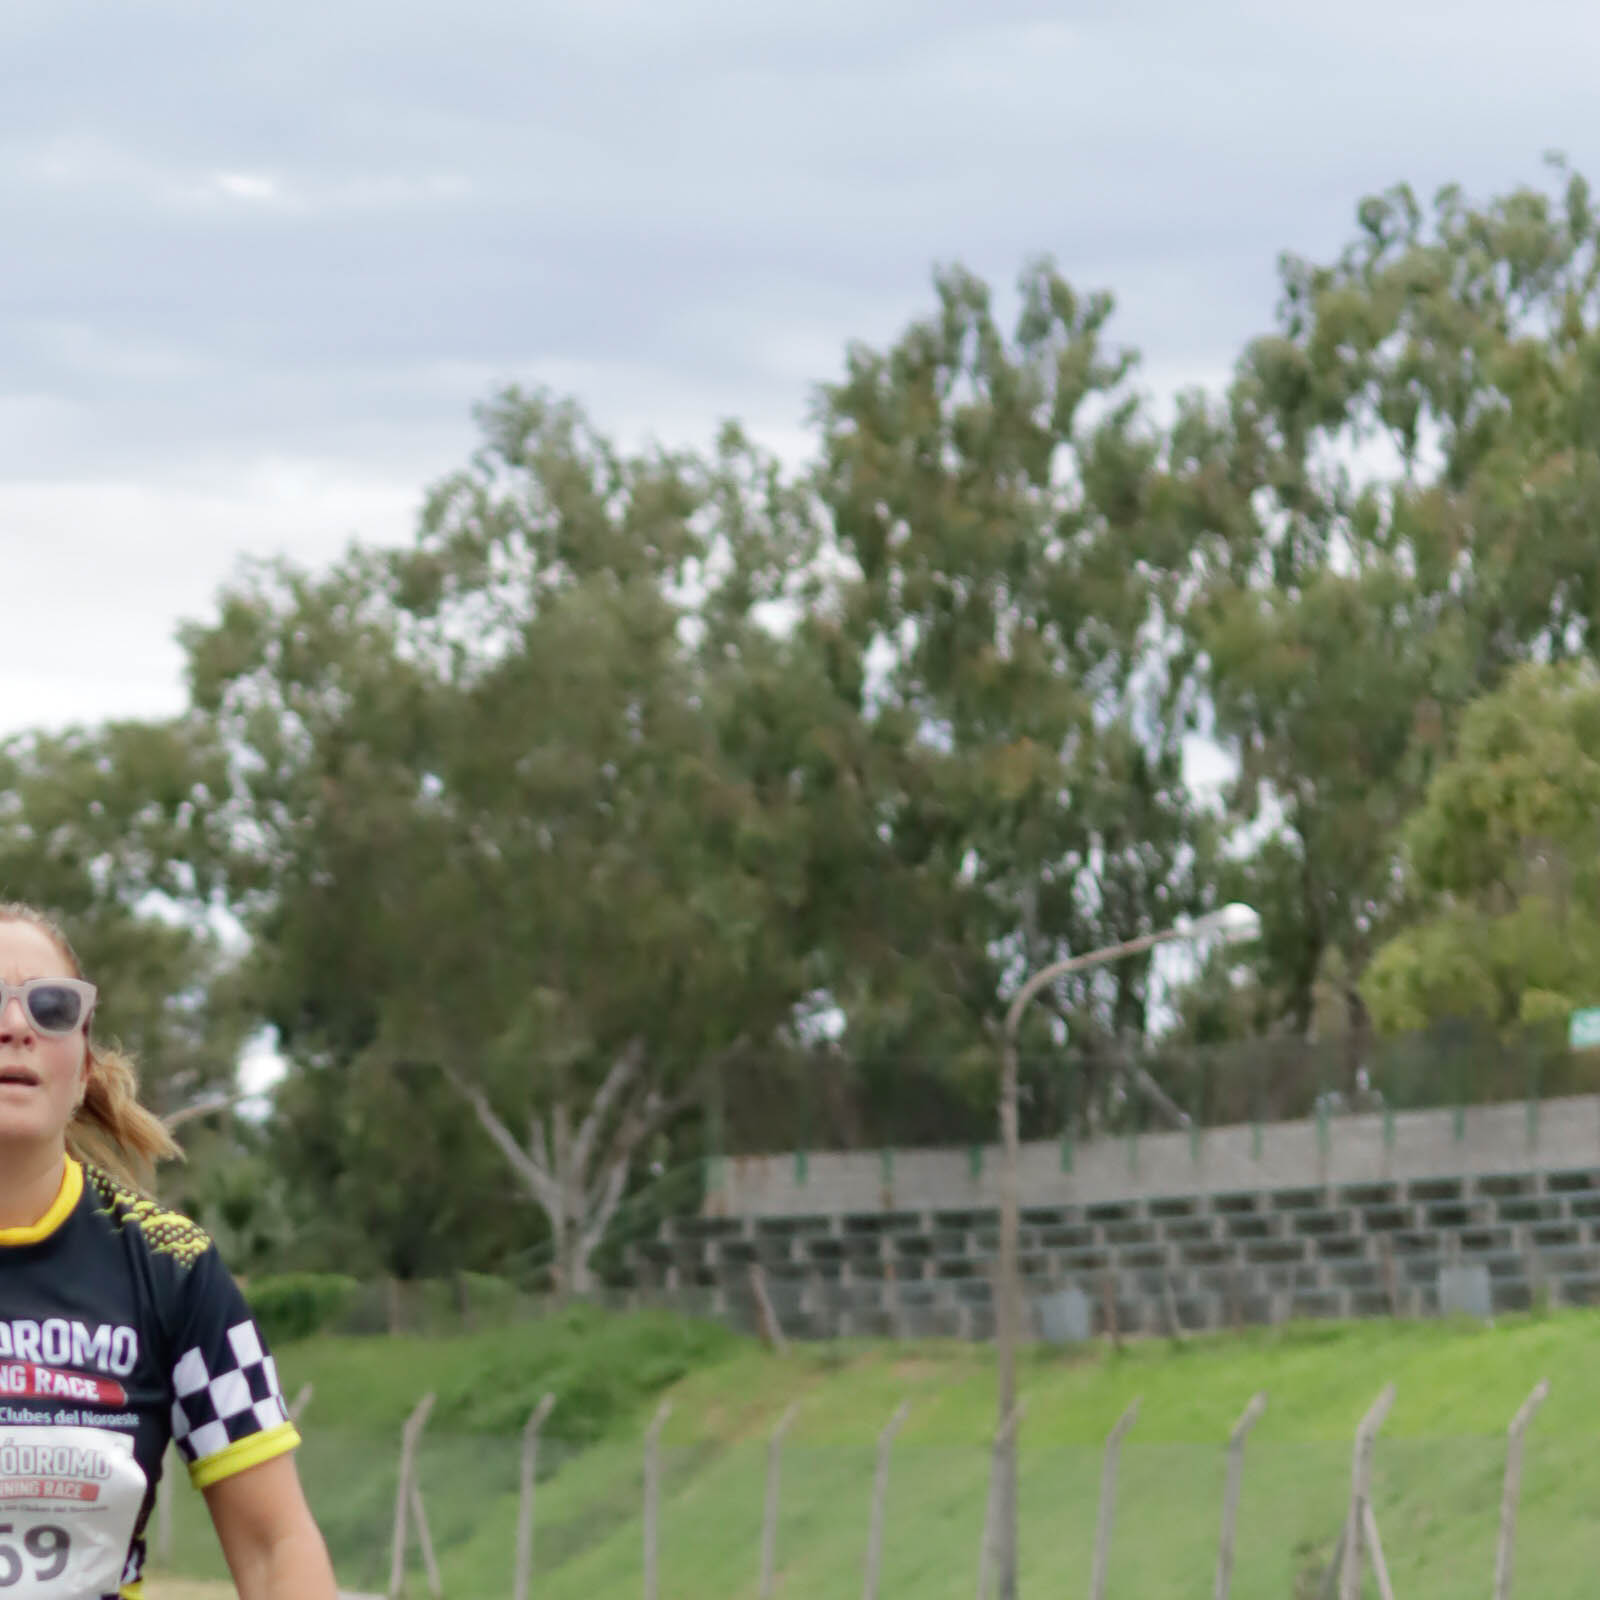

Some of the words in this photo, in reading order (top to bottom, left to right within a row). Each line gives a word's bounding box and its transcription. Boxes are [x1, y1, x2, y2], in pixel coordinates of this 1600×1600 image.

[34, 1368, 100, 1400] RACE
[54, 1409, 80, 1424] del
[82, 1410, 139, 1426] Noroeste
[43, 1481, 82, 1500] RACE
